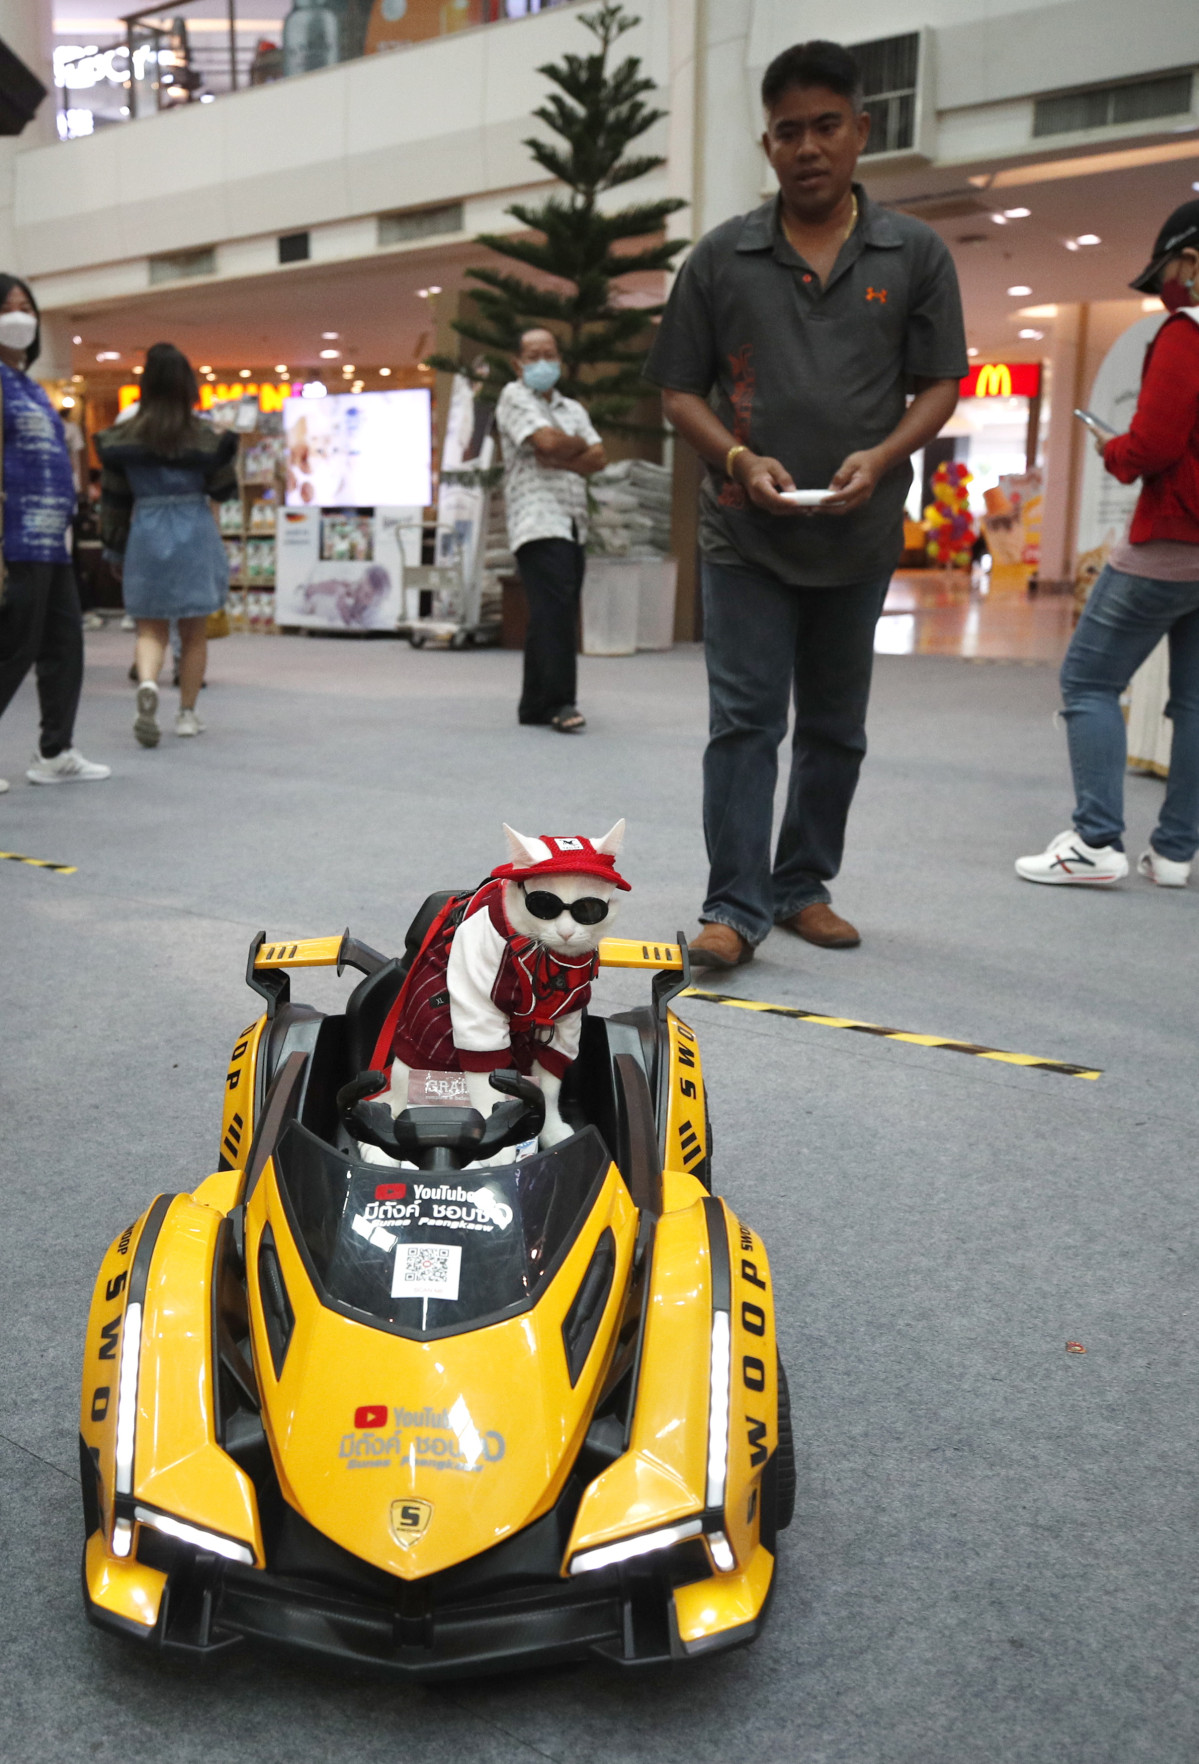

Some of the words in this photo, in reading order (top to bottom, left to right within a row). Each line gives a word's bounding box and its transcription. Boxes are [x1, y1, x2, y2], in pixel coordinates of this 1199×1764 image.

[413, 1184, 477, 1203] YouTube
[394, 1407, 454, 1430] YouTub
[400, 1506, 420, 1527] S
